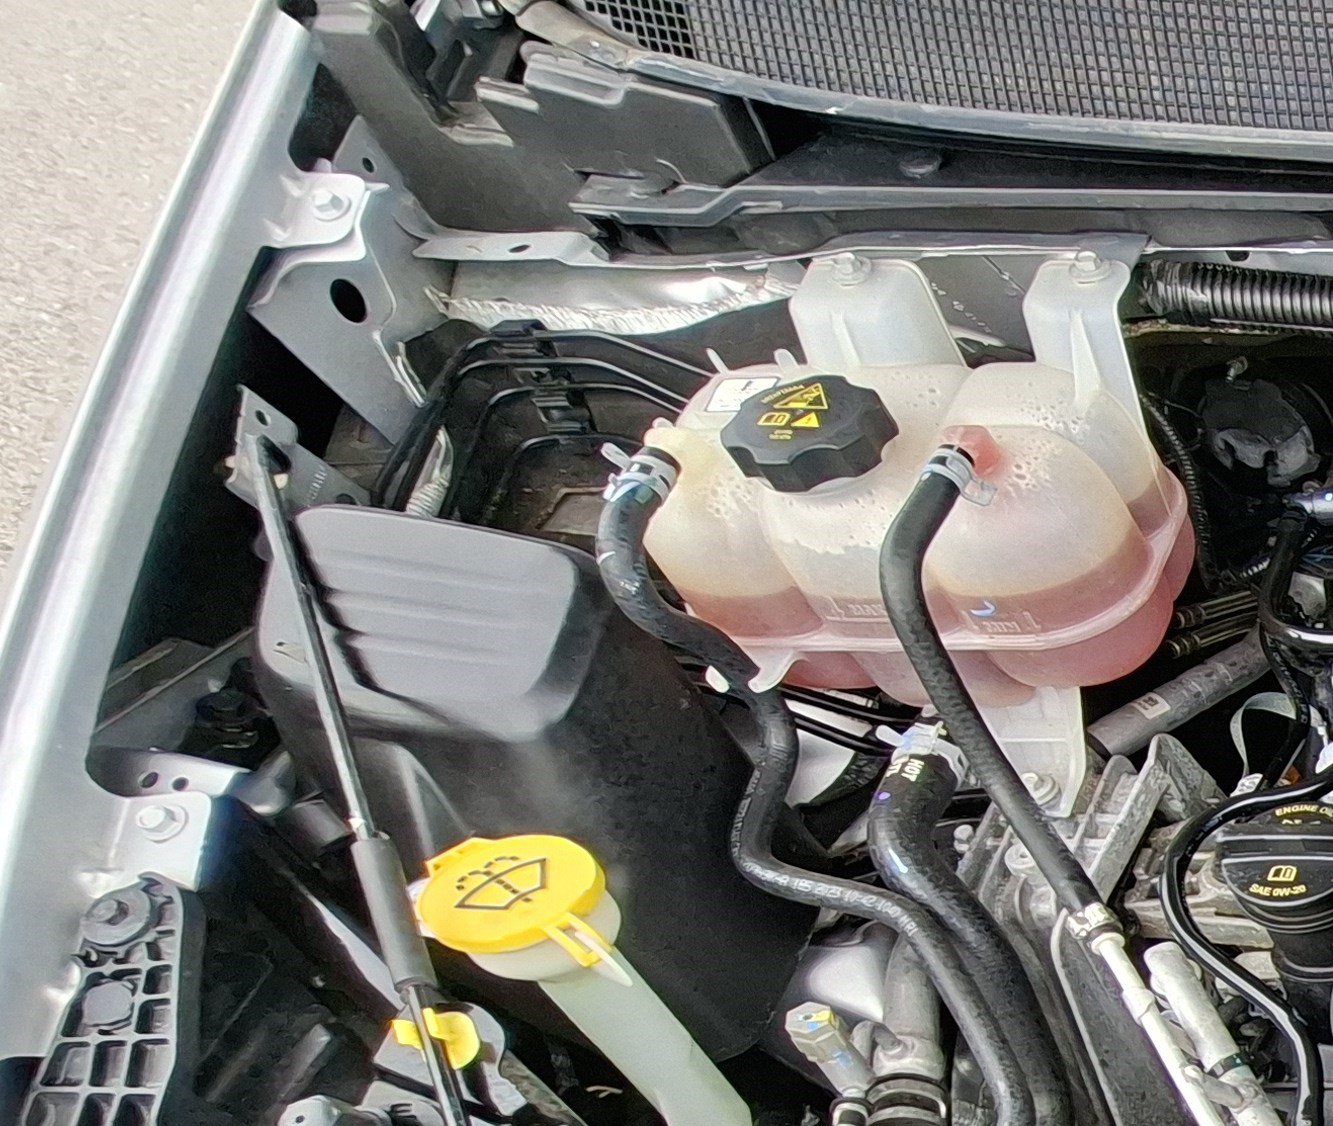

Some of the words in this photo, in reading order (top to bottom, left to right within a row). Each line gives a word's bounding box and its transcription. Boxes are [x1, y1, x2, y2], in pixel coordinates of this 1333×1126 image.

[901, 758, 925, 782] HOT
[1275, 804, 1319, 818] ENGINE
[1249, 883, 1271, 896] SAE
[1272, 884, 1307, 897] 0W-20
